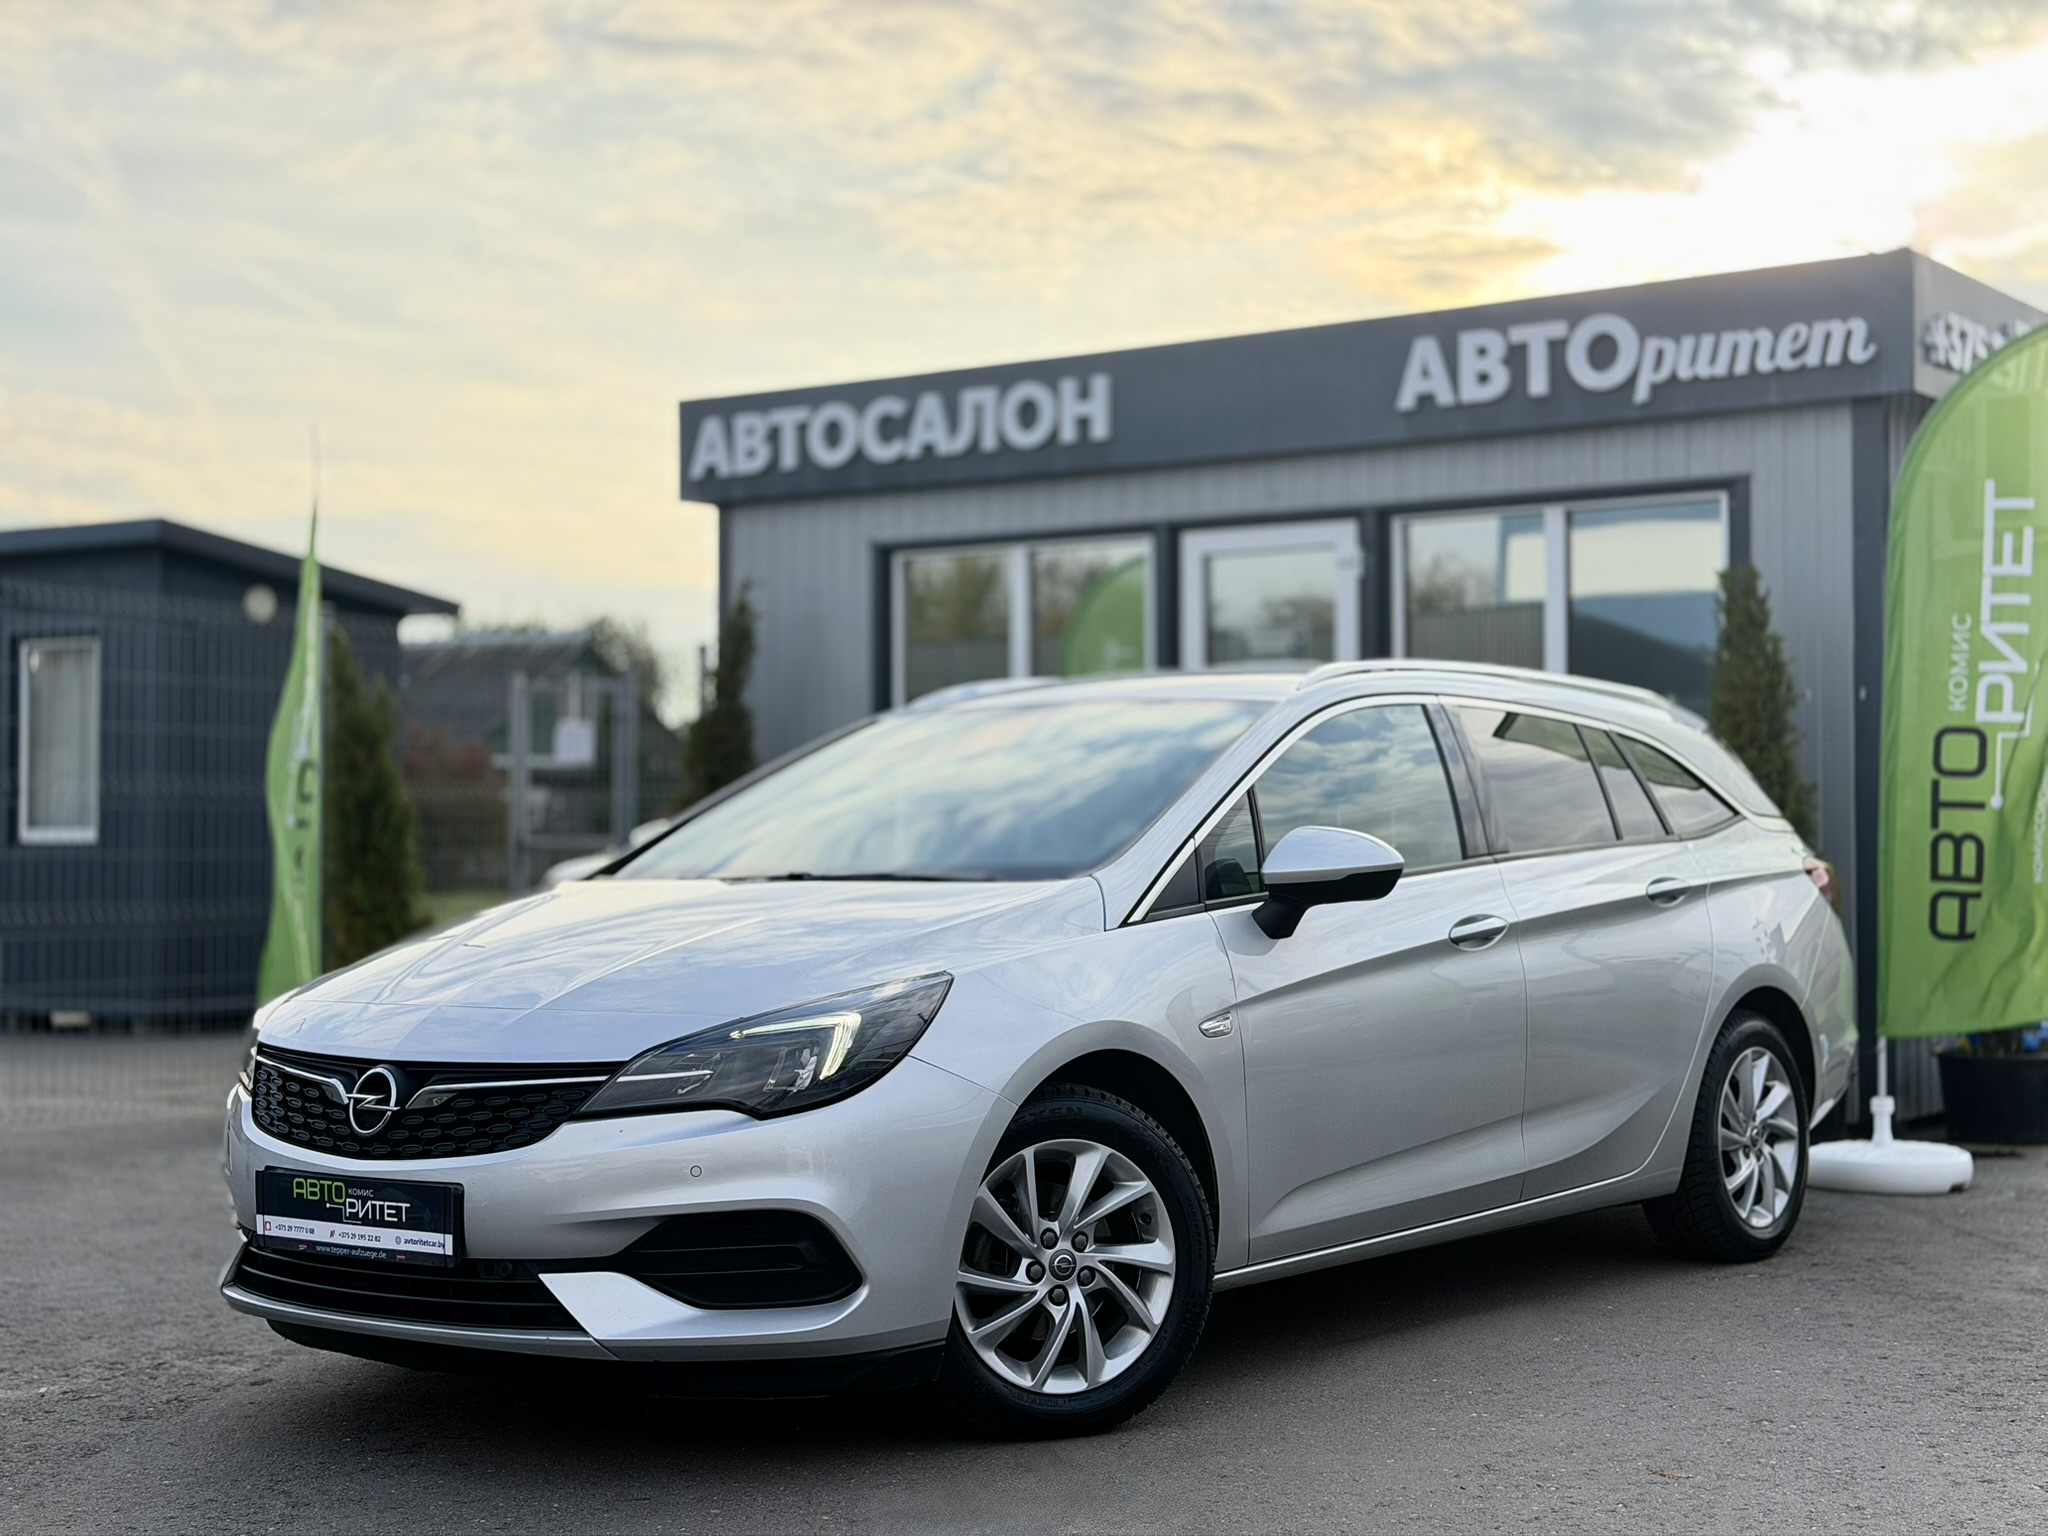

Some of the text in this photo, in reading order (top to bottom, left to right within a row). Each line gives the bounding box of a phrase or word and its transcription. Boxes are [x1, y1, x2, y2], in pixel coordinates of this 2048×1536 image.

[1397, 312, 1877, 412] АВТОритет
[687, 374, 1112, 481] АВТОСАЛОН
[1974, 478, 2036, 723] РИТЕТ
[1948, 613, 1971, 712] КОМИС
[1928, 726, 1988, 943] АВТО
[293, 1178, 346, 1203] АВТО
[346, 1198, 411, 1222] РИТЕТ
[348, 1188, 374, 1197] КОМИС
